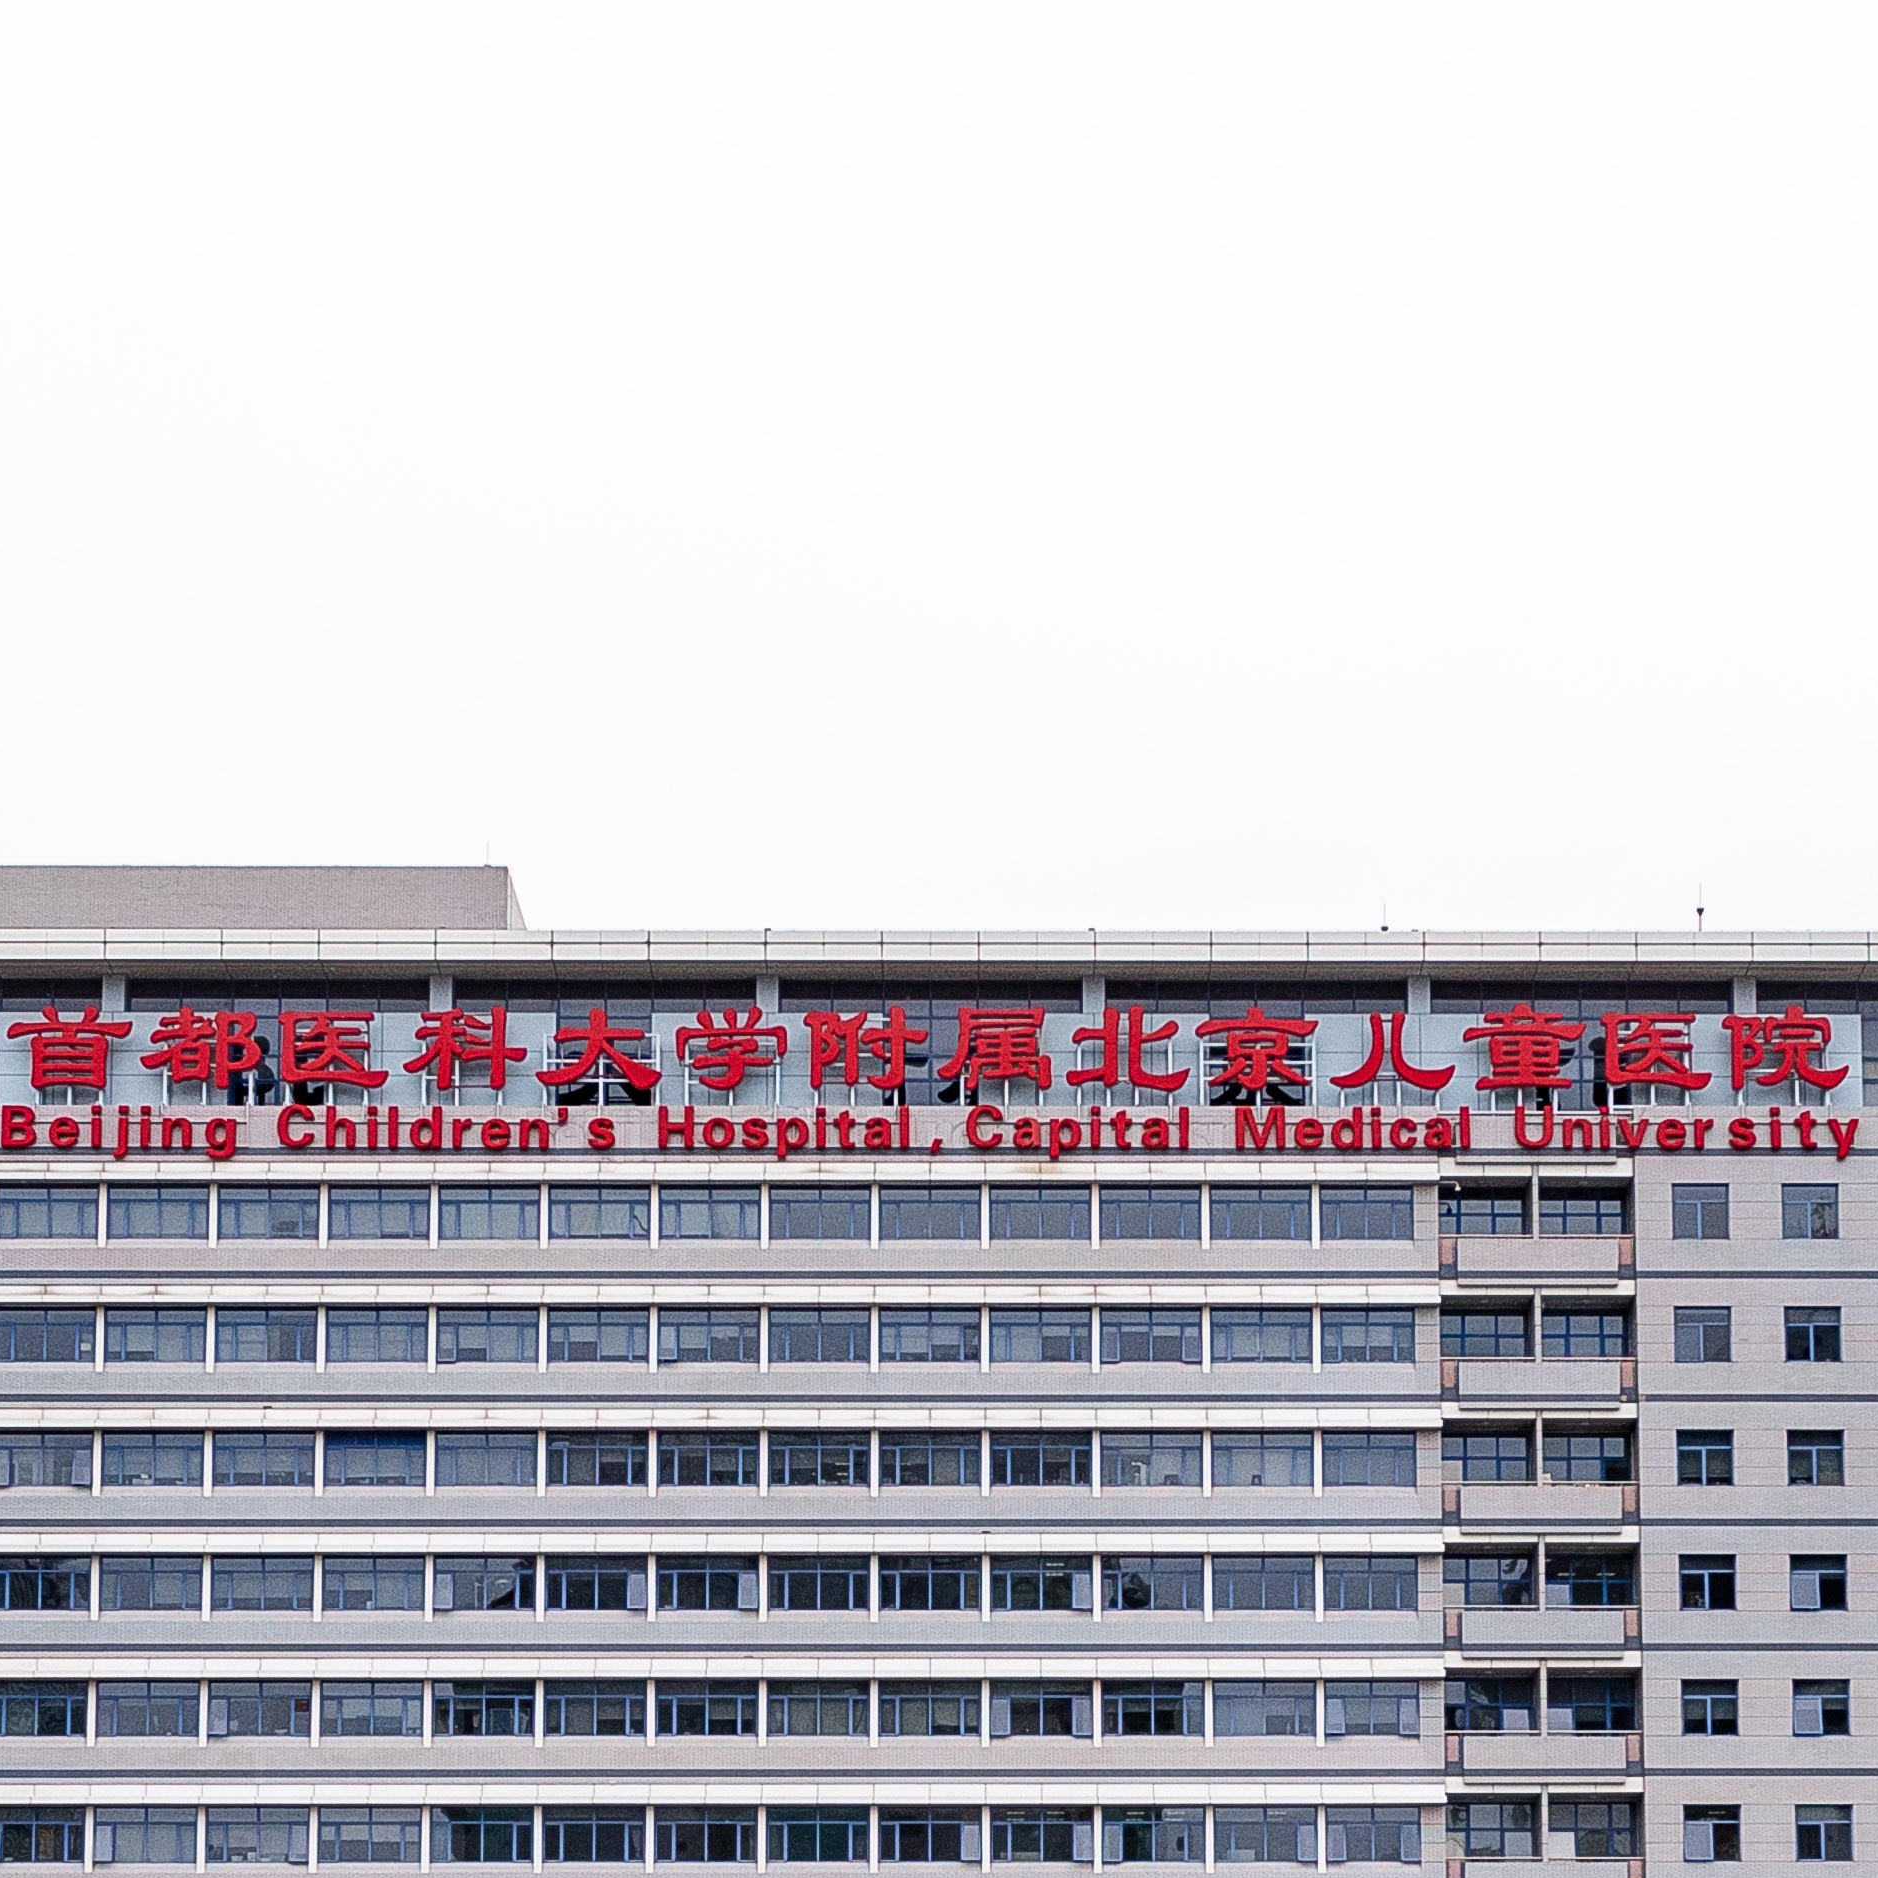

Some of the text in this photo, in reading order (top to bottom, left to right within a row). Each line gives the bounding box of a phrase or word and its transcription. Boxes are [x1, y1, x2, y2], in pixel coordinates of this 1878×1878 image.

[7, 1003, 1849, 1092] 首都医科大学附属北京儿童医院
[0, 1105, 237, 1159] Beijing
[657, 1104, 942, 1158] Hospital,
[965, 1104, 1191, 1159] Capital
[1234, 1104, 1472, 1150] Medical
[1513, 1104, 1859, 1159] University
